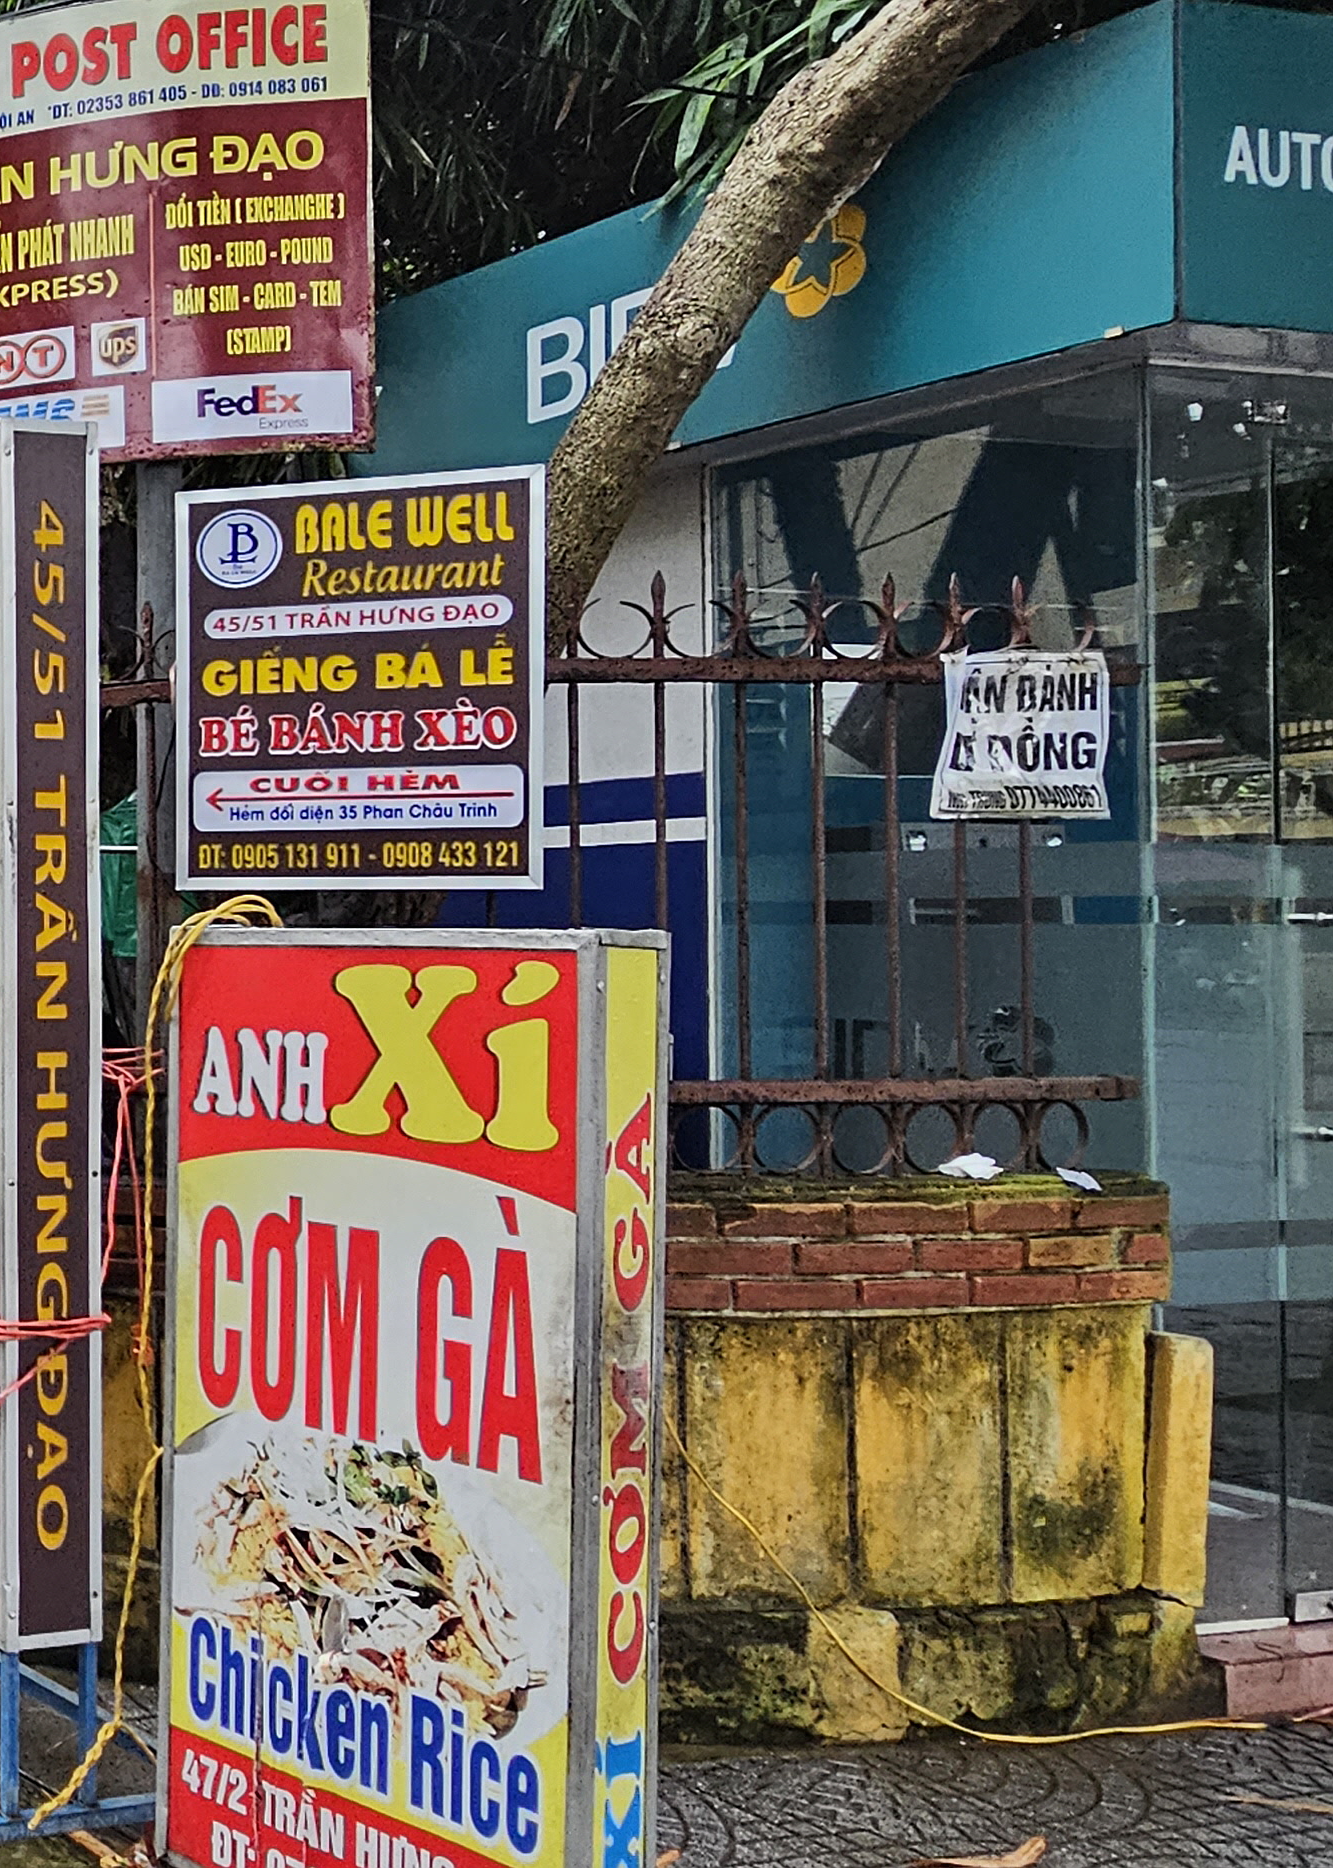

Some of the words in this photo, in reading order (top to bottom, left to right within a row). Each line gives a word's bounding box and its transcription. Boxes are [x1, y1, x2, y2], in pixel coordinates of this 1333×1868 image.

[11, 22, 137, 98] POST
[155, 4, 328, 74] OFFICE
[17, 109, 35, 127] AN
[76, 95, 124, 115] 02353
[128, 89, 155, 107] 861
[158, 85, 187, 104] 405
[229, 80, 263, 98] 0914
[268, 78, 296, 95] 083
[301, 76, 328, 94] 061
[49, 136, 198, 195] HƯNG
[209, 130, 325, 182] ĐẠO
[17, 216, 65, 271] PHÁT
[69, 213, 135, 263] NHANH
[179, 243, 212, 272] USD
[225, 239, 267, 268] EURO
[280, 236, 334, 265] POUND
[173, 283, 205, 316] BÁN
[209, 284, 240, 313] SIM
[253, 281, 296, 310] CARD
[309, 280, 342, 307] TEM
[196, 383, 304, 418] FedEx
[259, 416, 309, 430] Express
[294, 500, 393, 555] BALE
[405, 490, 515, 549] WELL
[301, 552, 505, 599] Restaurant
[31, 498, 68, 741] 45/51
[212, 613, 277, 634] 45/51
[358, 604, 436, 628] HƯNG
[441, 601, 500, 626] ĐẠO
[201, 644, 358, 698] GIẾNG
[375, 642, 444, 690] BÁ
[198, 704, 260, 758] BÉ
[268, 701, 406, 756] BÁNH
[413, 696, 518, 752] XÈO
[339, 805, 358, 820] 35
[363, 804, 406, 820] Phan
[408, 801, 454, 819] Châu
[232, 843, 280, 870] 0905
[285, 843, 319, 869] 131
[325, 843, 362, 869] 911
[382, 841, 433, 869] 0908
[437, 841, 477, 868] 433
[482, 840, 519, 868] 121
[33, 773, 78, 1021] TRẦN
[192, 1024, 329, 1126] ANH
[328, 959, 561, 1153] Xí
[34, 1051, 75, 1322] HƯNG
[603, 1091, 653, 1313] GÀ
[198, 1195, 381, 1444] CƠM
[415, 1195, 544, 1486] GÀ
[27, 1347, 69, 1551] ĐẠO
[602, 1360, 650, 1687] CƠM
[189, 1616, 390, 1797] Chicken
[409, 1692, 541, 1857] Rice
[181, 1747, 248, 1816] 47/2
[261, 1780, 346, 1861] TRẦN
